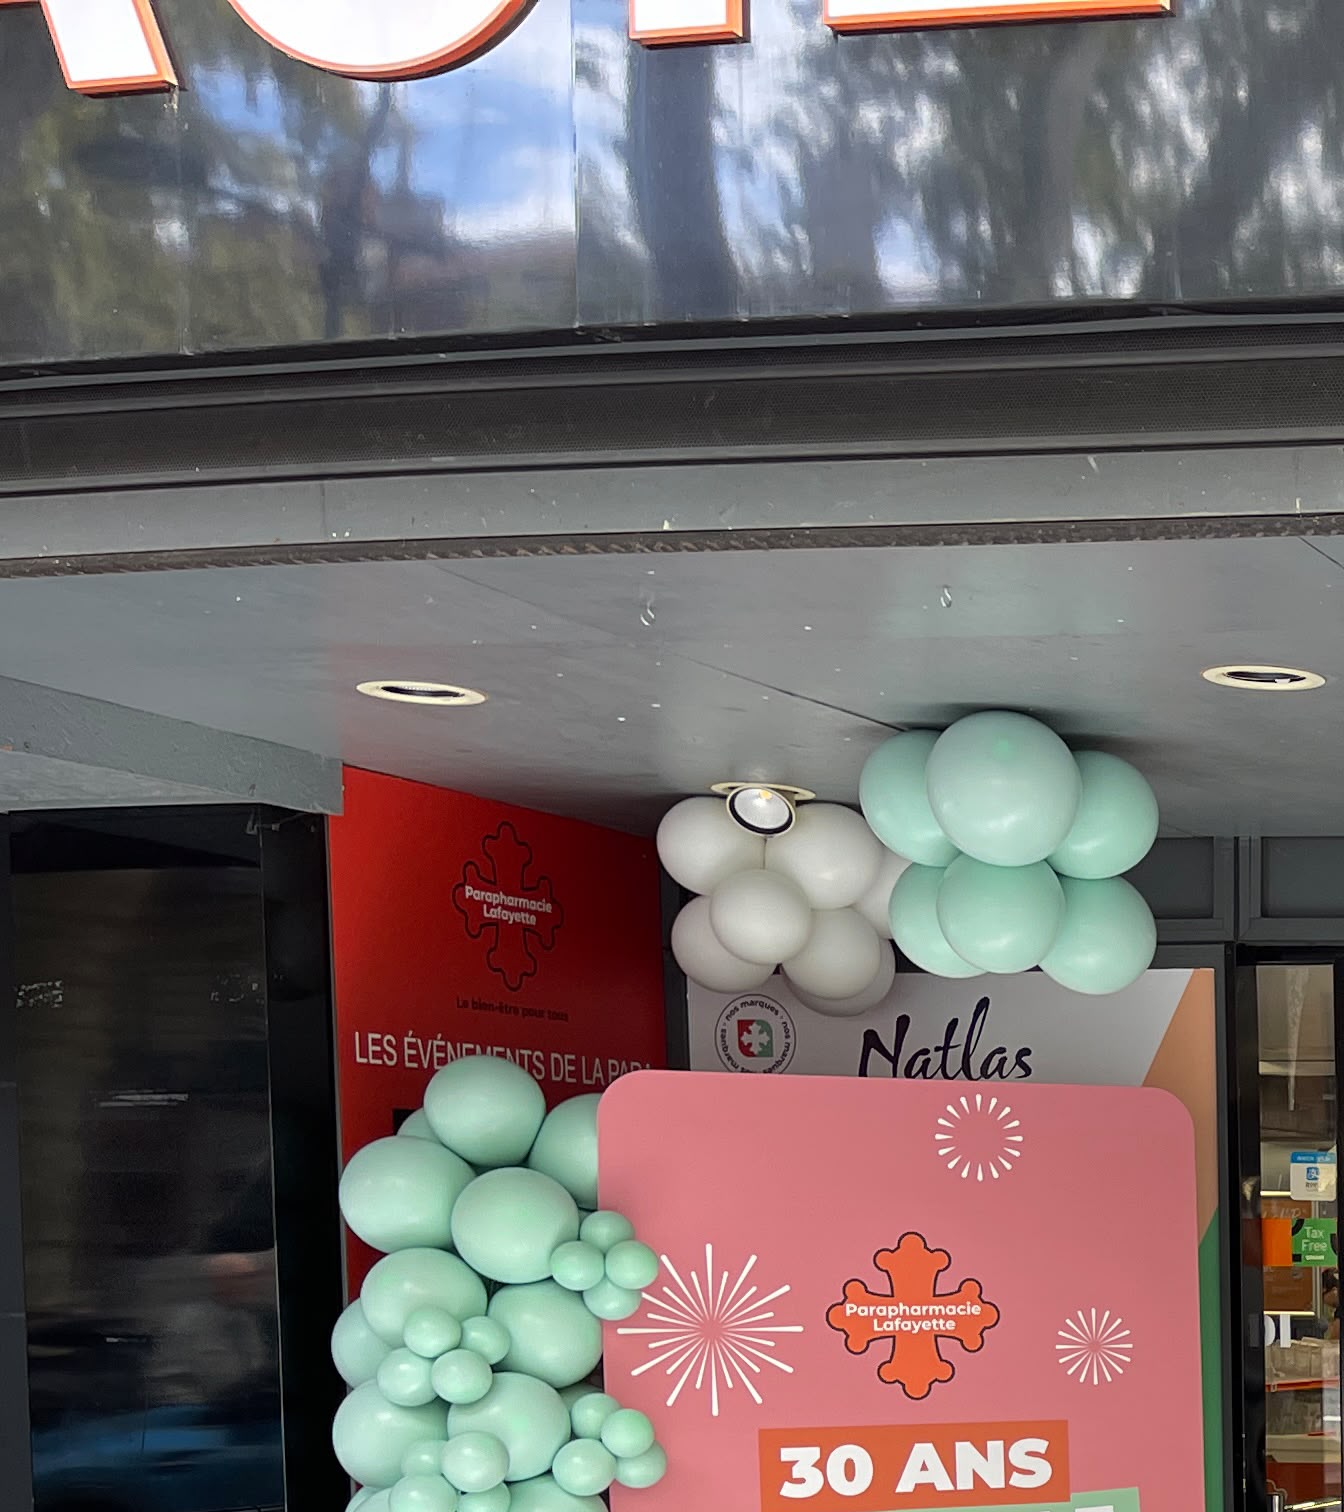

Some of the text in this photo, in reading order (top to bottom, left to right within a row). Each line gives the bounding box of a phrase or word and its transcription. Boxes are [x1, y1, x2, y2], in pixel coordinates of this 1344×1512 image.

[464, 885, 553, 914] Parapharmacie
[483, 904, 537, 926] Lafayette
[740, 1000, 779, 1016] marques
[858, 996, 1033, 1081] Natlas
[354, 1030, 398, 1067] LES
[551, 1053, 577, 1083] DE
[581, 1056, 605, 1085] LA
[1304, 1226, 1324, 1239] Tax
[1301, 1239, 1328, 1252] Free
[845, 1301, 982, 1318] Parapharmacie
[873, 1318, 956, 1334] Lafayette
[779, 1437, 1053, 1499] 30 ANS
